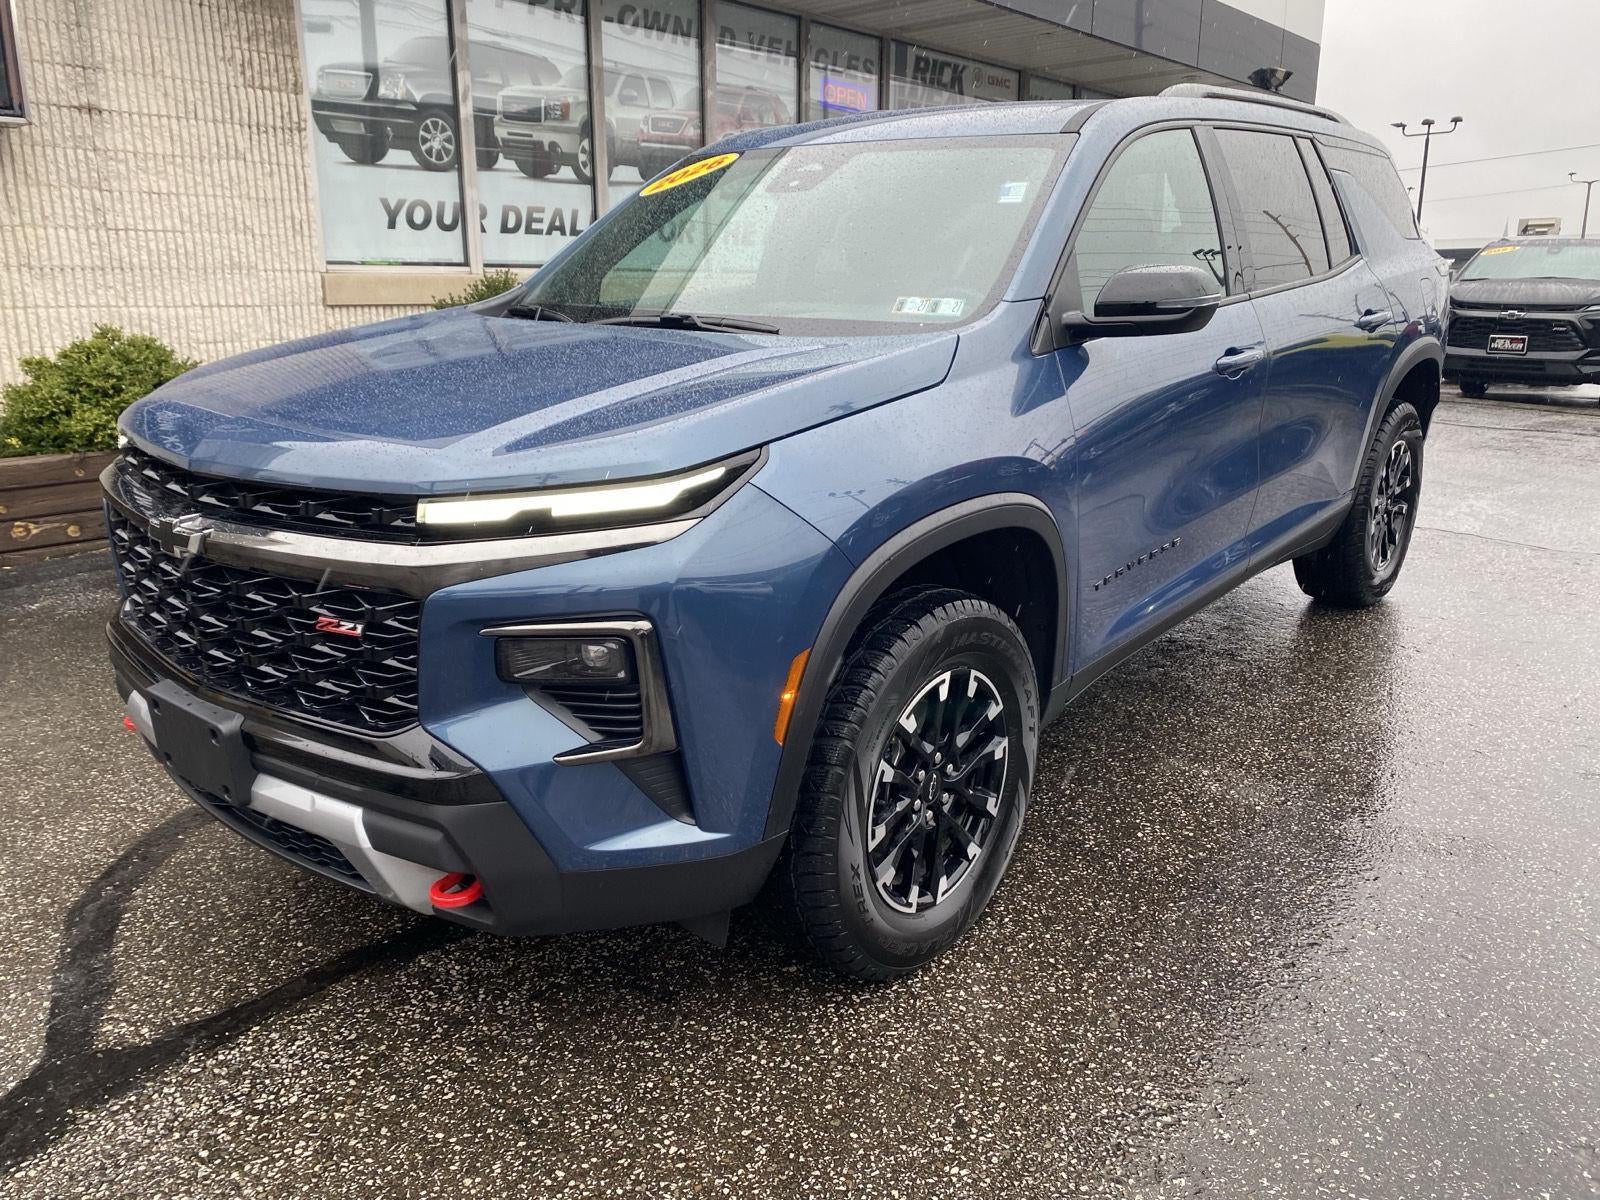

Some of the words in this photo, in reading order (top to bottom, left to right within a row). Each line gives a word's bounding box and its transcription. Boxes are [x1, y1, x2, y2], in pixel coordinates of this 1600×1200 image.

[745, 31, 875, 83] VEHCLES
[912, 55, 968, 95] RICK
[987, 74, 1011, 89] GMC
[824, 84, 867, 111] OPEN
[500, 205, 592, 237] DEAL
[1094, 537, 1181, 591] TRAVERSE
[315, 616, 364, 637] Z71
